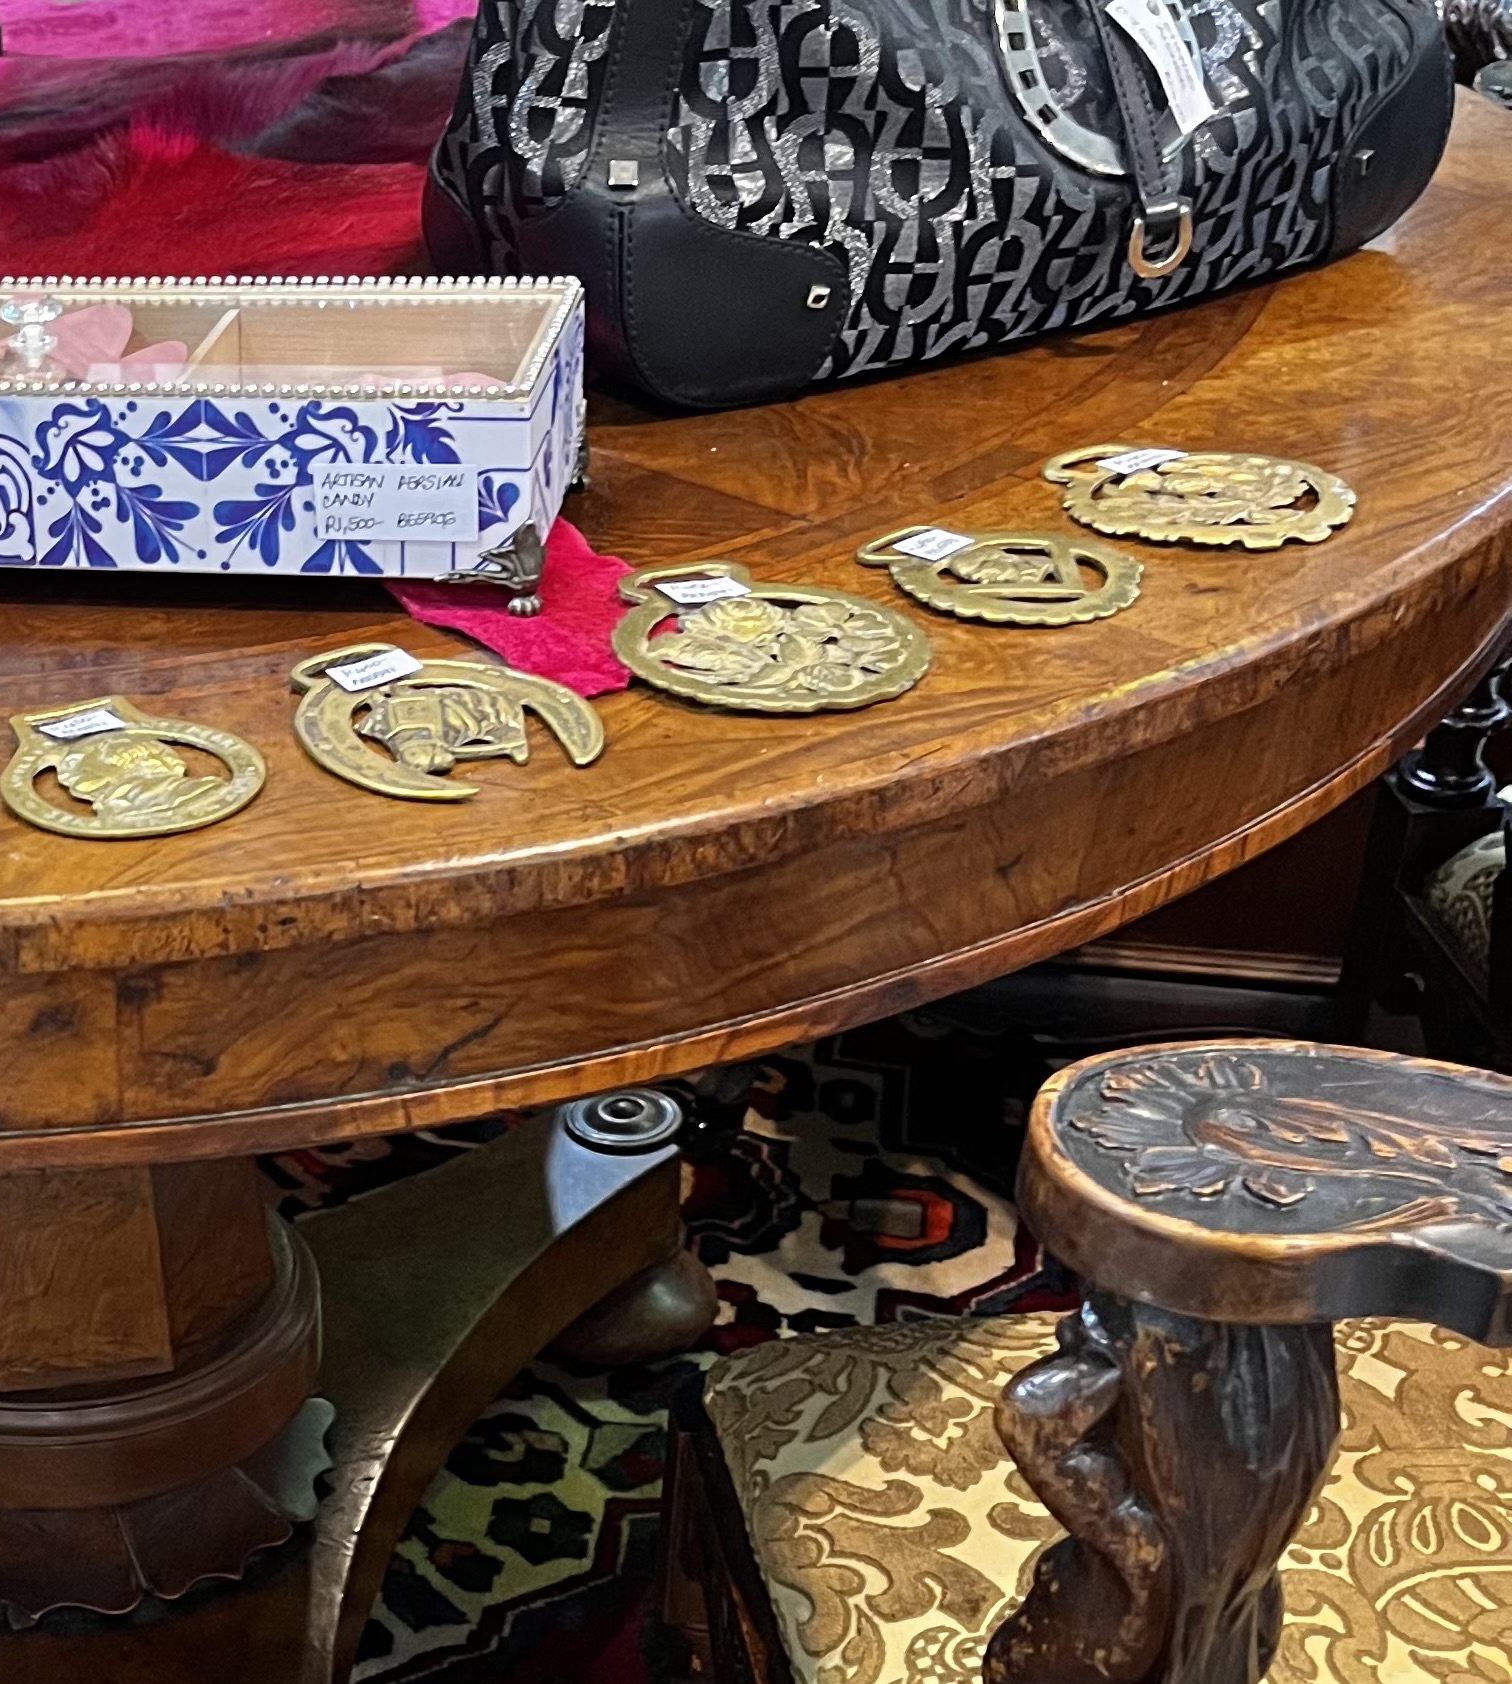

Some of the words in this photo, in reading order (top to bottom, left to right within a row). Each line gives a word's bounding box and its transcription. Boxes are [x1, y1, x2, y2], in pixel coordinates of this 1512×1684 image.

[321, 473, 385, 489] ARTISAN
[397, 473, 465, 490] PERSIAN
[322, 492, 375, 508] CANDY
